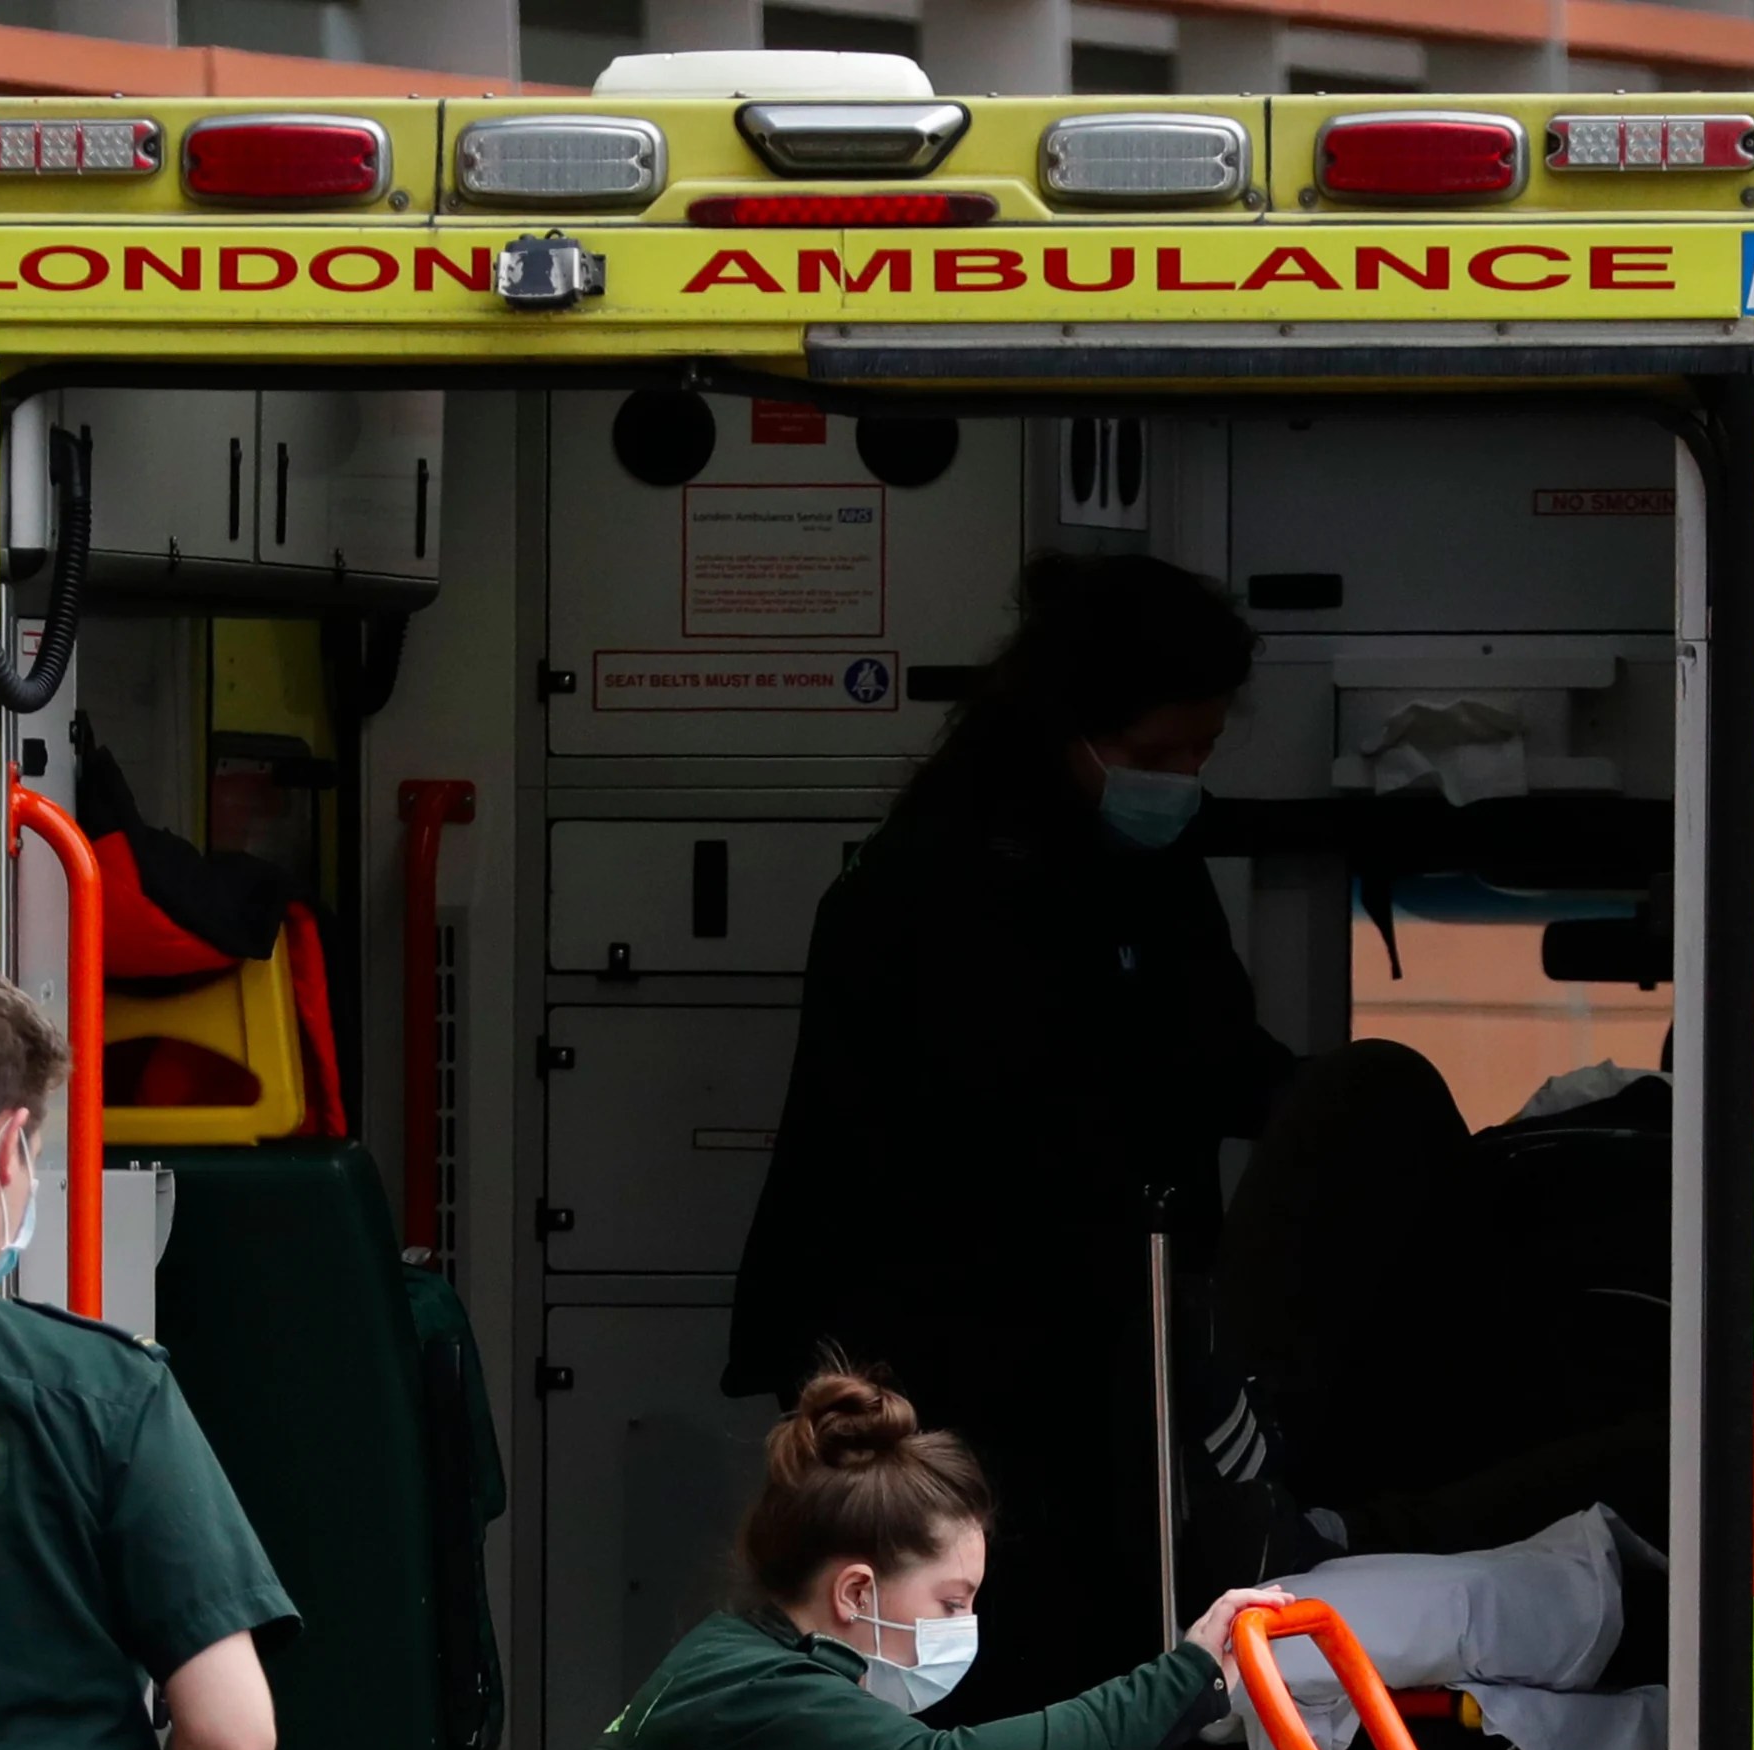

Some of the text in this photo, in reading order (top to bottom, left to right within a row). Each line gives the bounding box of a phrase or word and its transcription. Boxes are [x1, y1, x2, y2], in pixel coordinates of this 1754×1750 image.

[682, 245, 1675, 293] AMBULANCE
[1592, 493, 1676, 511] SMOKIN
[605, 673, 834, 688] SEAT BELTS MUST BE WORN
